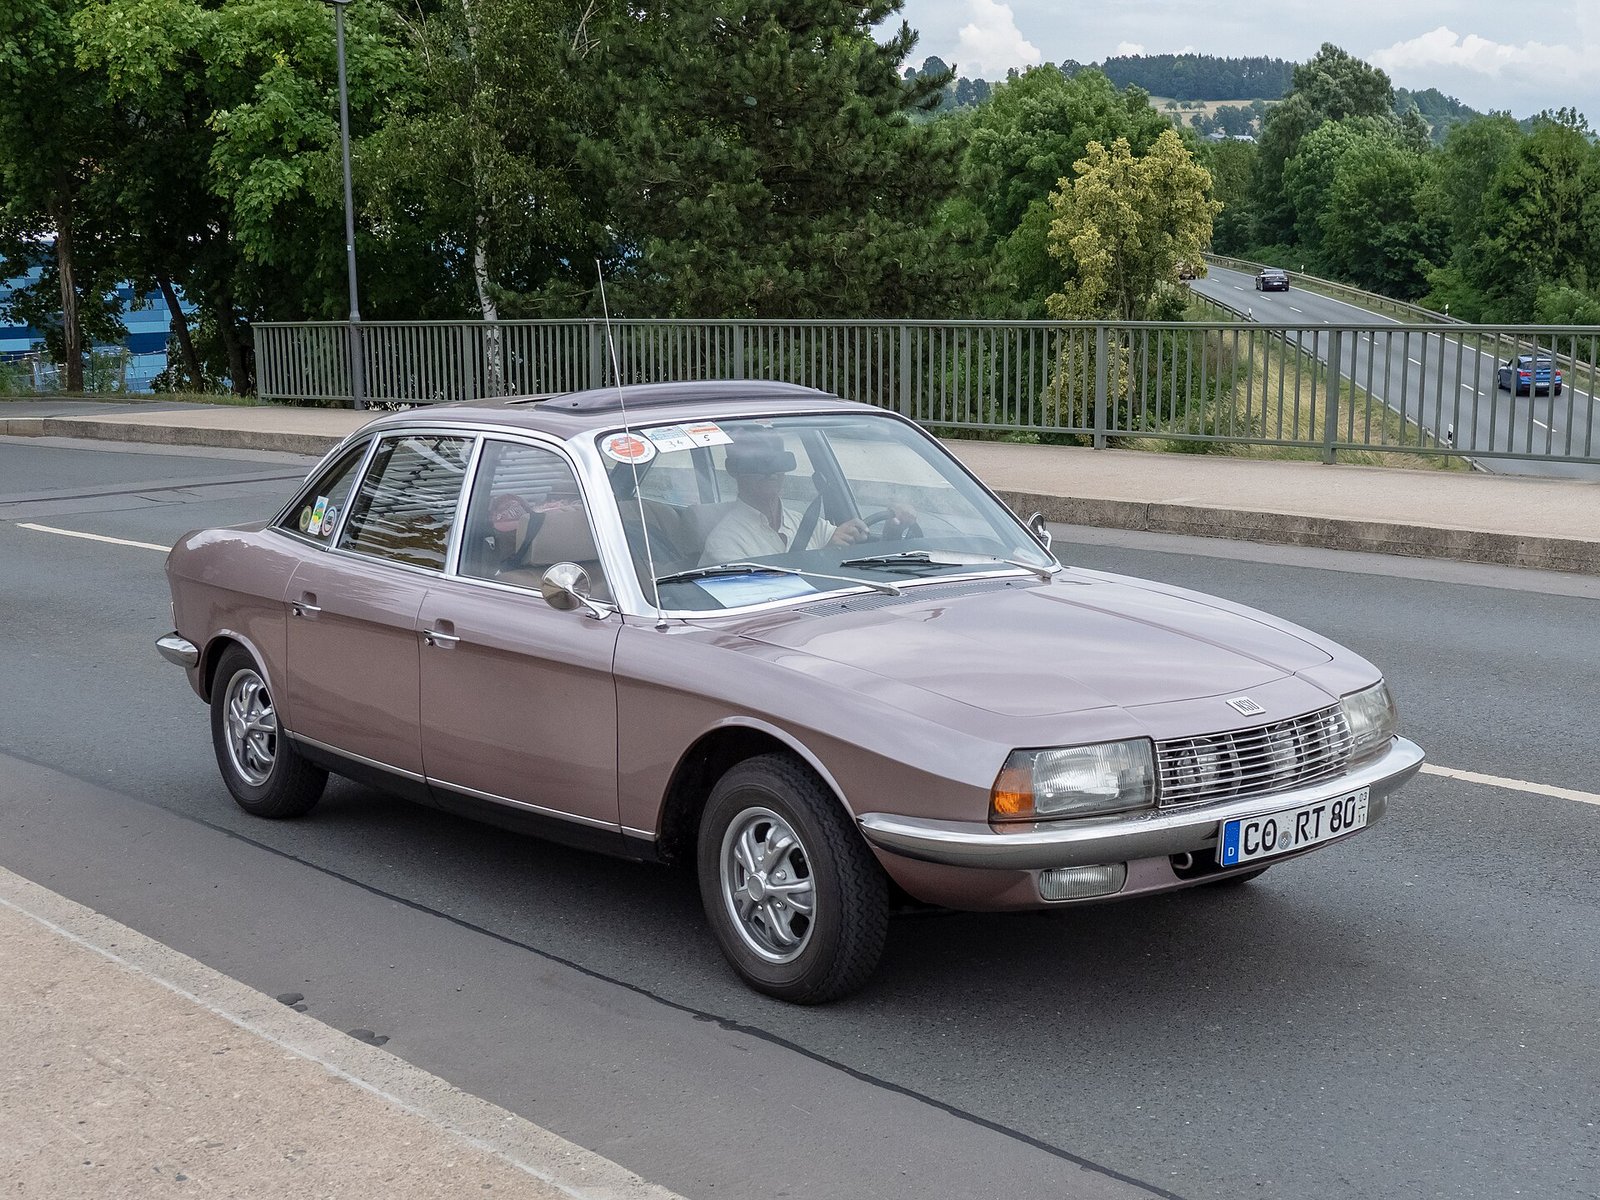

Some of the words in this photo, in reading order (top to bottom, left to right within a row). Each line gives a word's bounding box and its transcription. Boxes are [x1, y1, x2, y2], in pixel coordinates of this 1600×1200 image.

[1232, 698, 1260, 713] NSU
[1359, 791, 1367, 802] 03
[1358, 813, 1365, 823] 11
[1243, 818, 1278, 856] CO
[1295, 806, 1325, 844] RT
[1330, 796, 1356, 833] 80
[1227, 846, 1235, 857] D
